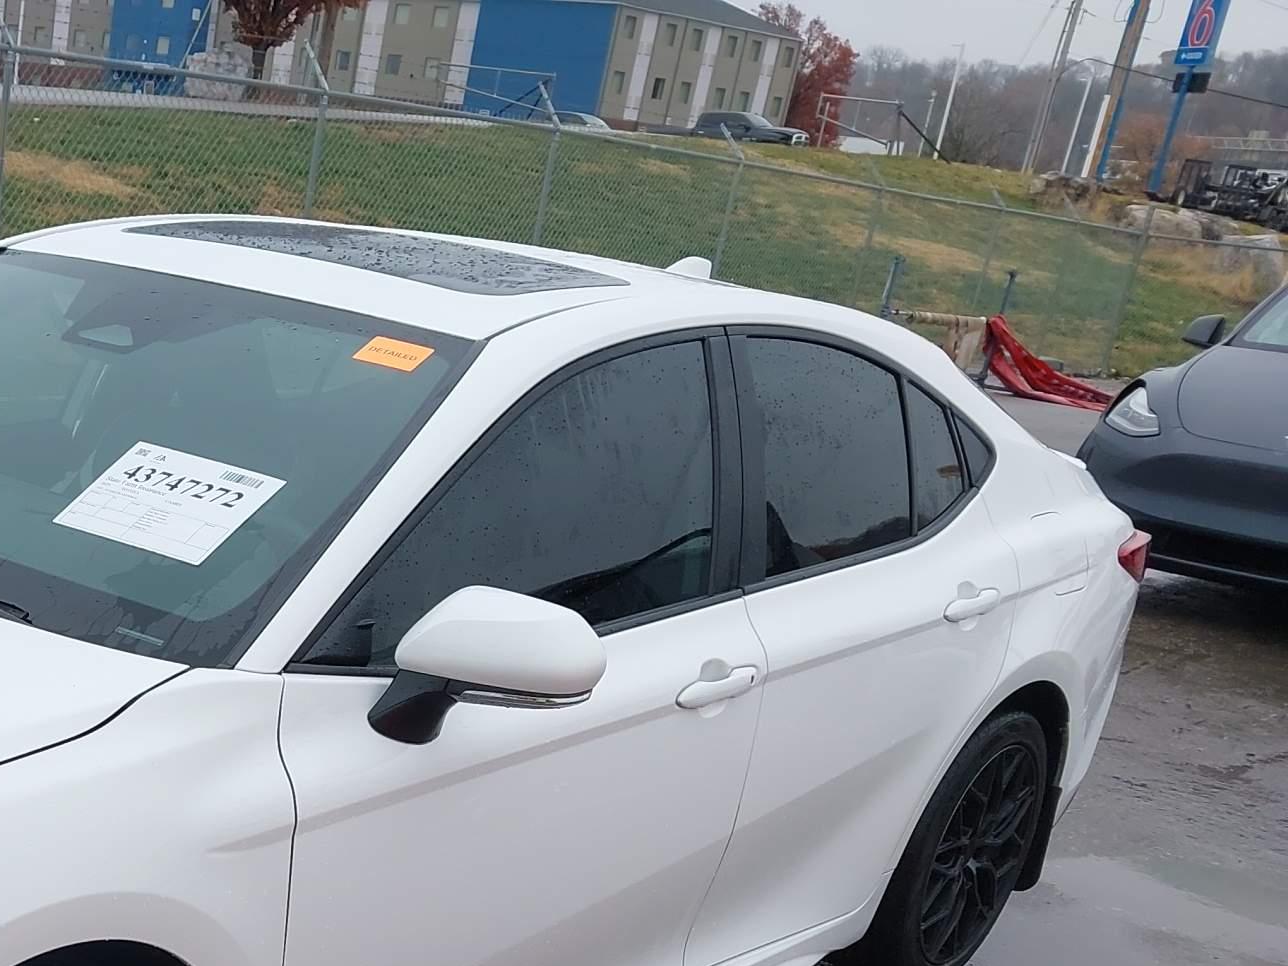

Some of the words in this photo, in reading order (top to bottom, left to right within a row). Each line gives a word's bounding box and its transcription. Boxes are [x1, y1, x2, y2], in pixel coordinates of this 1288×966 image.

[1188, 0, 1215, 48] 6
[367, 345, 418, 361] DETAILED
[123, 465, 244, 508] 43747272
